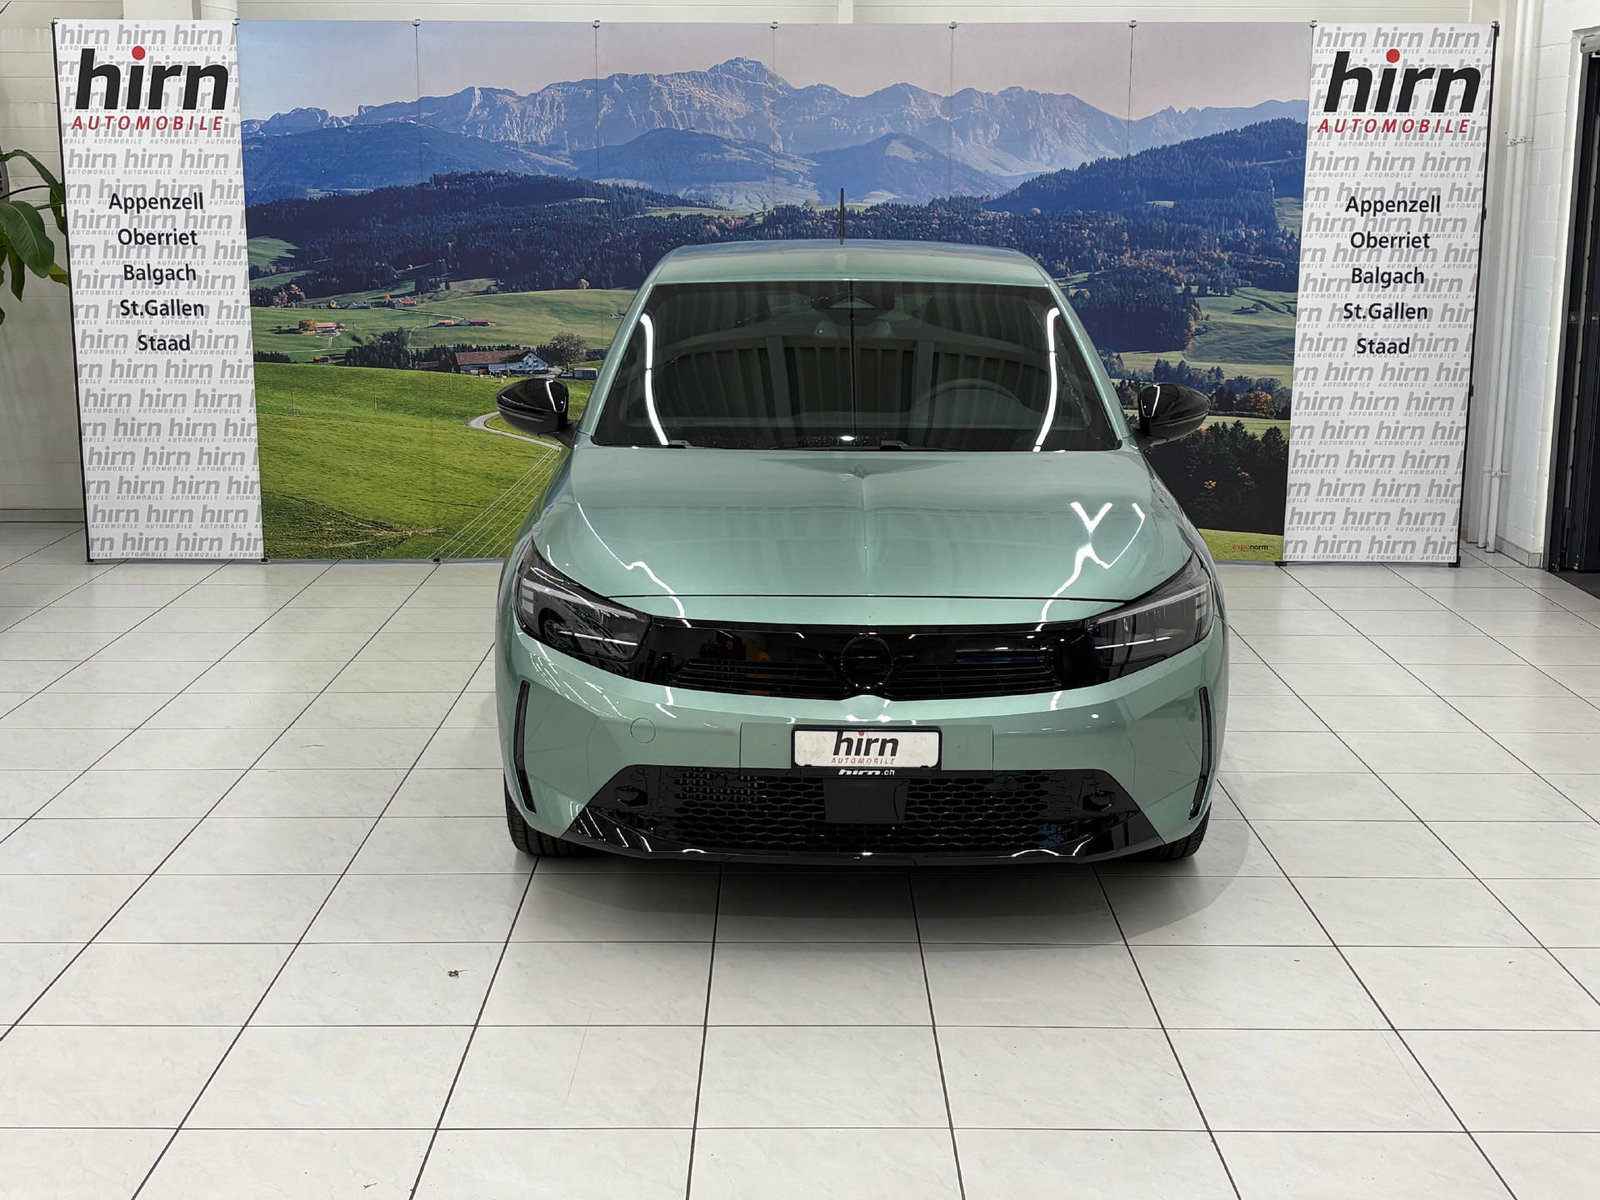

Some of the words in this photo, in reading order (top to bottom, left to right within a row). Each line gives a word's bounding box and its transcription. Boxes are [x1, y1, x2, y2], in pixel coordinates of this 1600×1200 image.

[60, 24, 109, 44] hirn
[117, 24, 166, 44] hirn
[173, 24, 222, 44] hirn
[1317, 27, 1367, 47] hirn
[1373, 27, 1423, 48] hirn
[1429, 28, 1480, 48] hirn
[75, 46, 229, 110] hirn
[1323, 48, 1481, 113] hirn
[71, 116, 223, 130] AUTOMOBILE
[1317, 119, 1470, 134] AUTOMOBILE
[69, 148, 117, 168] hirn
[124, 148, 173, 168] hirn
[180, 148, 229, 168] hirn
[1310, 151, 1360, 171] hirn
[1366, 151, 1416, 171] hirn
[1421, 152, 1471, 172] hirn
[108, 192, 204, 214] Appenzell
[1345, 195, 1440, 217] Appenzell
[118, 228, 198, 246] Oberriet
[1350, 232, 1430, 249] Oberriet
[124, 264, 196, 285] Balgach
[1352, 266, 1424, 288] Balgach
[120, 299, 204, 316] St.Gallen
[1343, 302, 1428, 320] St.Gallen
[80, 329, 128, 348] hirn
[191, 329, 239, 348] hirn
[138, 334, 190, 351] Staad
[1299, 332, 1347, 351] hirn
[1410, 333, 1459, 352] hirn
[1356, 338, 1410, 354] Staad
[110, 359, 158, 378] hirn
[165, 359, 213, 378] hirn
[1324, 362, 1374, 381] hirn
[1380, 362, 1429, 381] hirn
[84, 388, 132, 407] hirn
[139, 388, 187, 407] hirn
[194, 388, 242, 407] hirn
[1296, 391, 1344, 410] hirn
[1349, 391, 1399, 410] hirn
[1405, 392, 1455, 411] hirn
[114, 418, 161, 436] hirn
[168, 418, 217, 436] hirn
[1320, 420, 1370, 439] hirn
[1376, 421, 1425, 440] hirn
[88, 447, 135, 465] hirn
[143, 447, 191, 465] hirn
[197, 447, 245, 465] hirn
[1293, 450, 1340, 468] hirn
[1345, 450, 1395, 469] hirn
[1401, 450, 1450, 469] hirn
[117, 475, 165, 494] hirn
[172, 475, 220, 494] hirn
[1317, 478, 1366, 497] hirn
[1372, 478, 1421, 497] hirn
[92, 504, 139, 522] hirn
[146, 504, 194, 522] hirn
[201, 504, 249, 522] hirn
[1289, 507, 1337, 525] hirn
[1342, 508, 1391, 526] hirn
[1397, 508, 1446, 526] hirn
[122, 533, 169, 550] hirn
[176, 533, 224, 550] hirn
[1313, 535, 1362, 554] hirn
[1368, 535, 1416, 554] hirn
[832, 731, 899, 756] hirn
